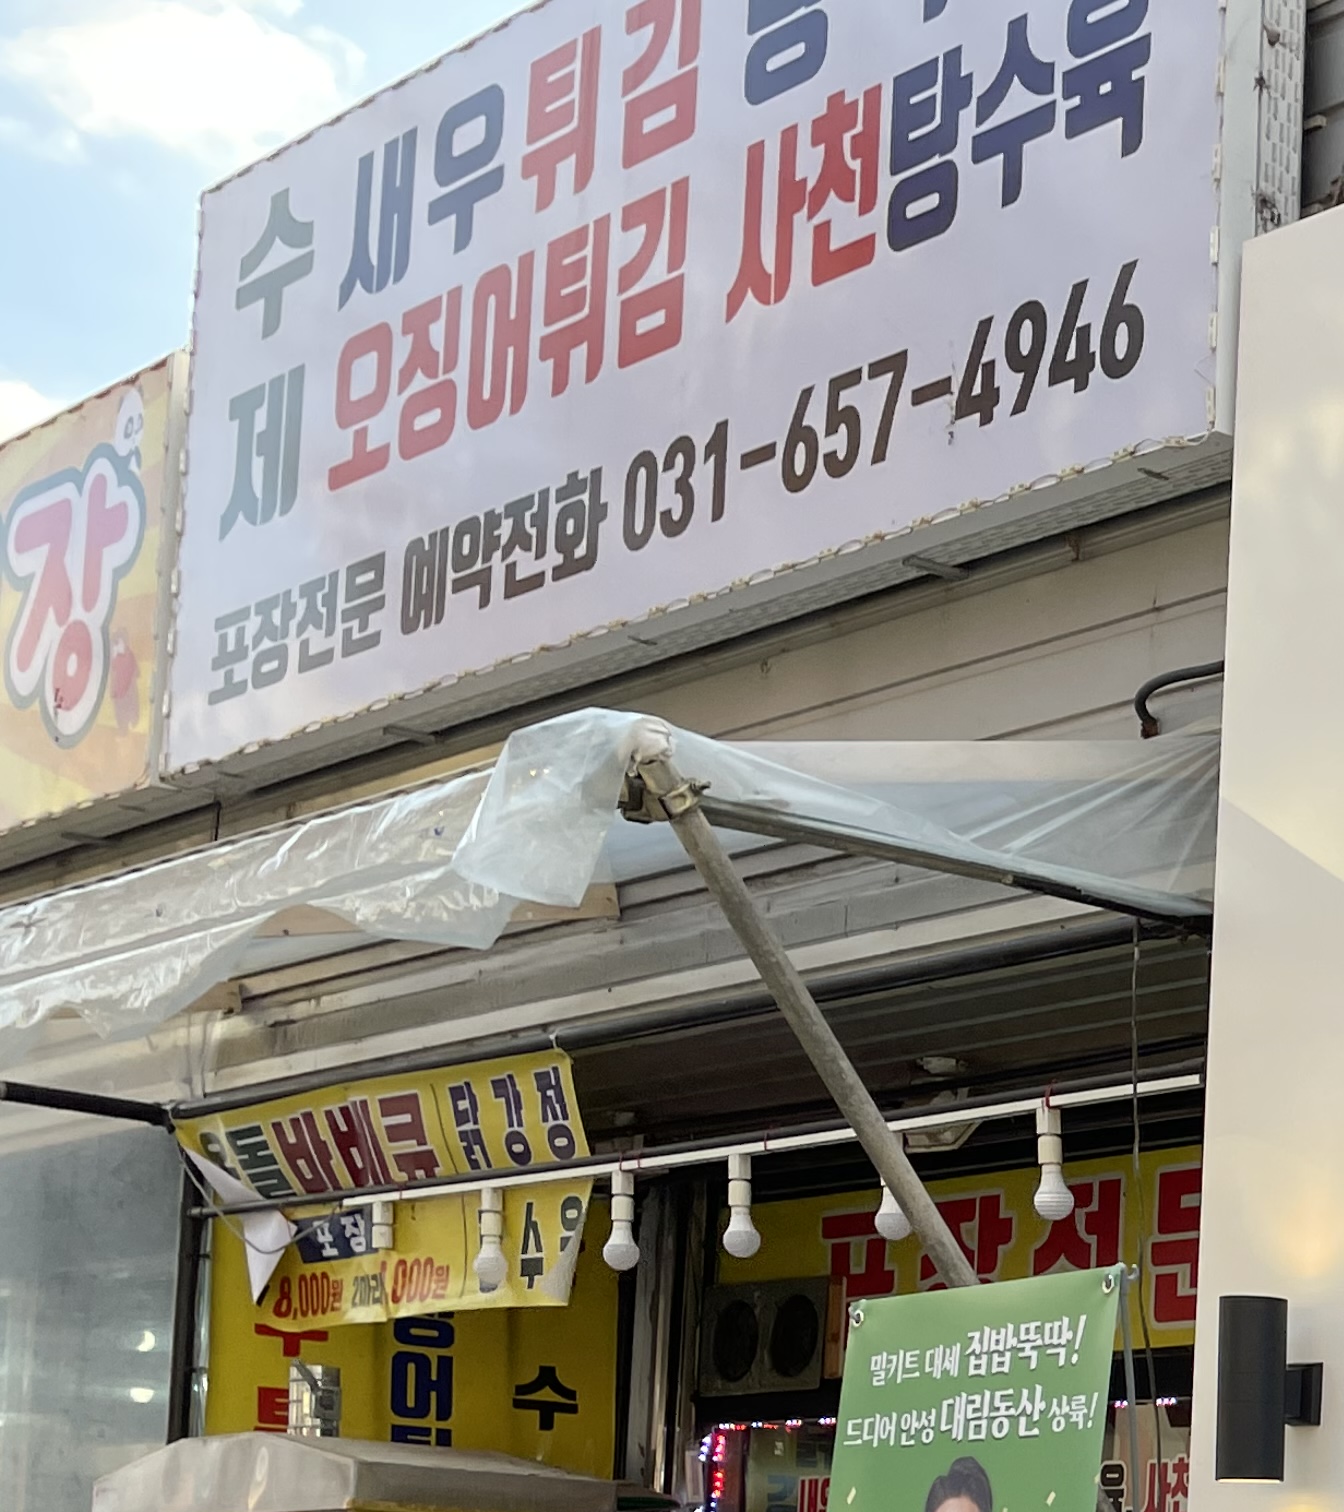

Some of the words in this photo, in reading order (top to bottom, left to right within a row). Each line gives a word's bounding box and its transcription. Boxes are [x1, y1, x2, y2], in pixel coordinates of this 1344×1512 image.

[328, 176, 690, 492] 오징어튀김
[725, 0, 1151, 324] 사천탕수육
[14, 472, 129, 712] 장
[208, 552, 388, 706] 포장전문
[402, 467, 608, 636] 예약전화
[623, 259, 1147, 553] 031-657-4946
[843, 1412, 896, 1448] 드디어
[900, 1408, 936, 1447] 안성
[940, 1384, 1046, 1443] 대림동산
[1047, 1391, 1099, 1433] 상륙!
[871, 1349, 920, 1387] 밀키트
[925, 1343, 961, 1380] 대세
[965, 1314, 1087, 1377] 집밥뚝딱!
